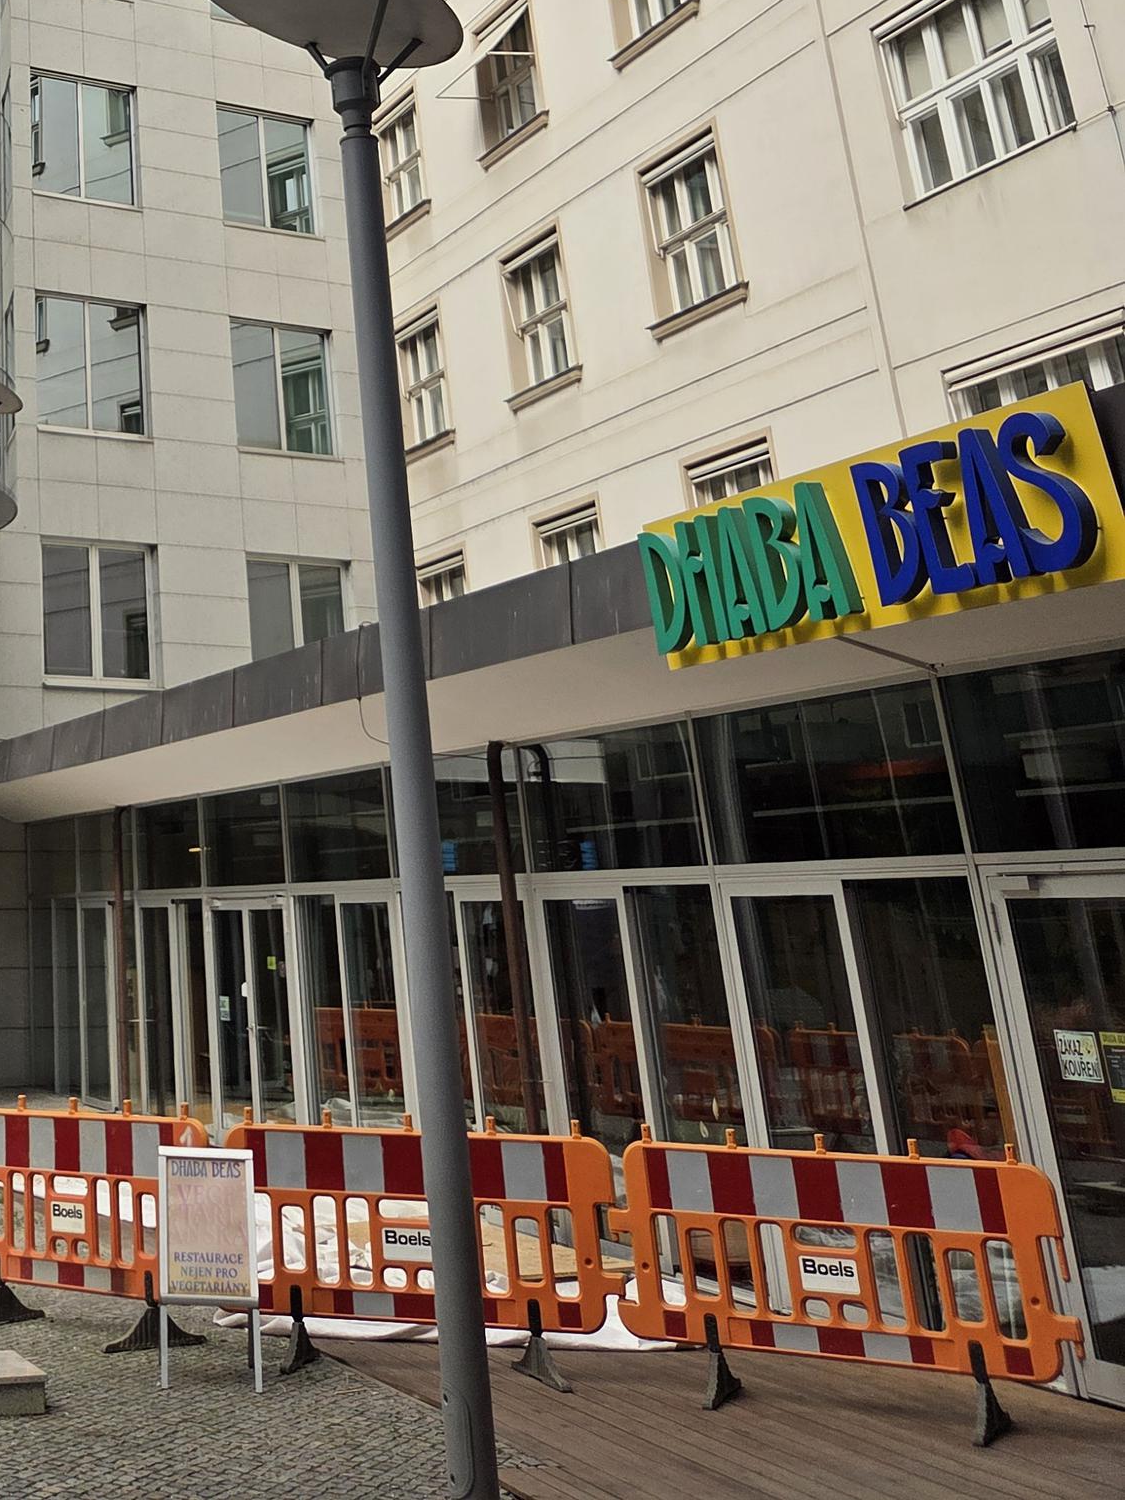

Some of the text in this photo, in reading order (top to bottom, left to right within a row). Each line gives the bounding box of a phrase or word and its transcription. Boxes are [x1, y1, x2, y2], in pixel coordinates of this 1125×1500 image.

[637, 412, 1098, 655] DHABA BEAS
[171, 1160, 241, 1178] DHABA BEAS
[52, 1203, 83, 1219] Boels
[384, 1230, 431, 1246] Boels
[174, 1251, 244, 1265] RESTAURACE
[180, 1265, 238, 1280] NEJEN PRO
[801, 1258, 855, 1277] Boels
